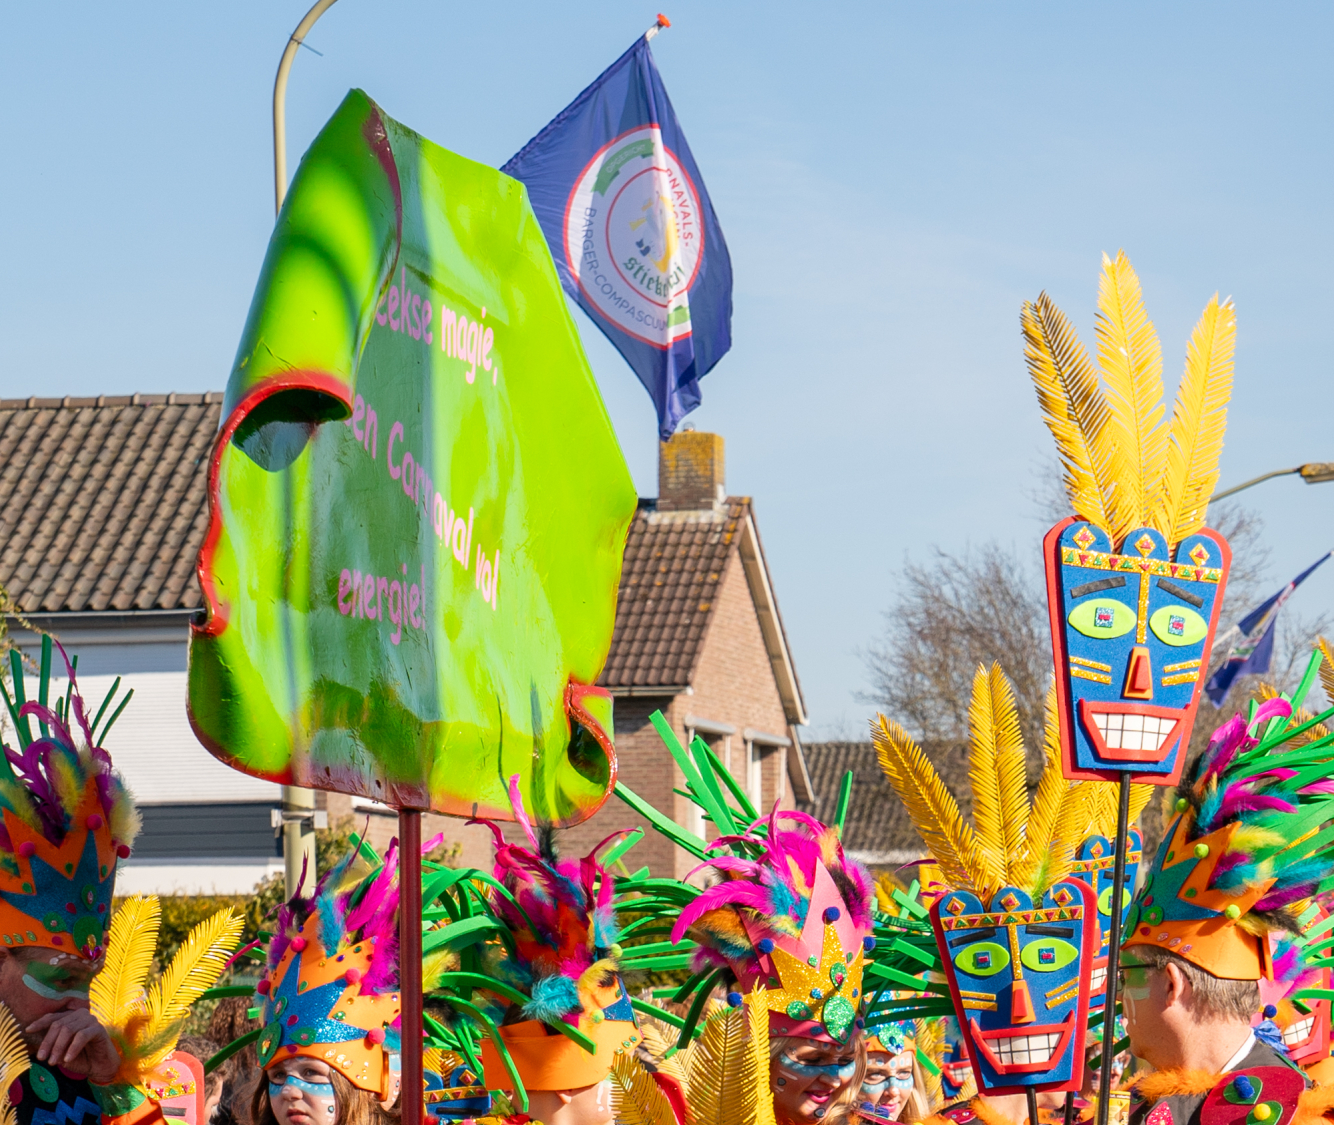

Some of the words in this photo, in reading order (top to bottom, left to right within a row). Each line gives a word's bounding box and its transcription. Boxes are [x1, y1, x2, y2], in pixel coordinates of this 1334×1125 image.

[582, 207, 668, 332] BARGER-COMPASCUU
[441, 306, 498, 386] magie,
[344, 393, 378, 459] en
[387, 421, 474, 570] Carnaval
[475, 544, 500, 611] vol
[338, 563, 426, 645] energie!
